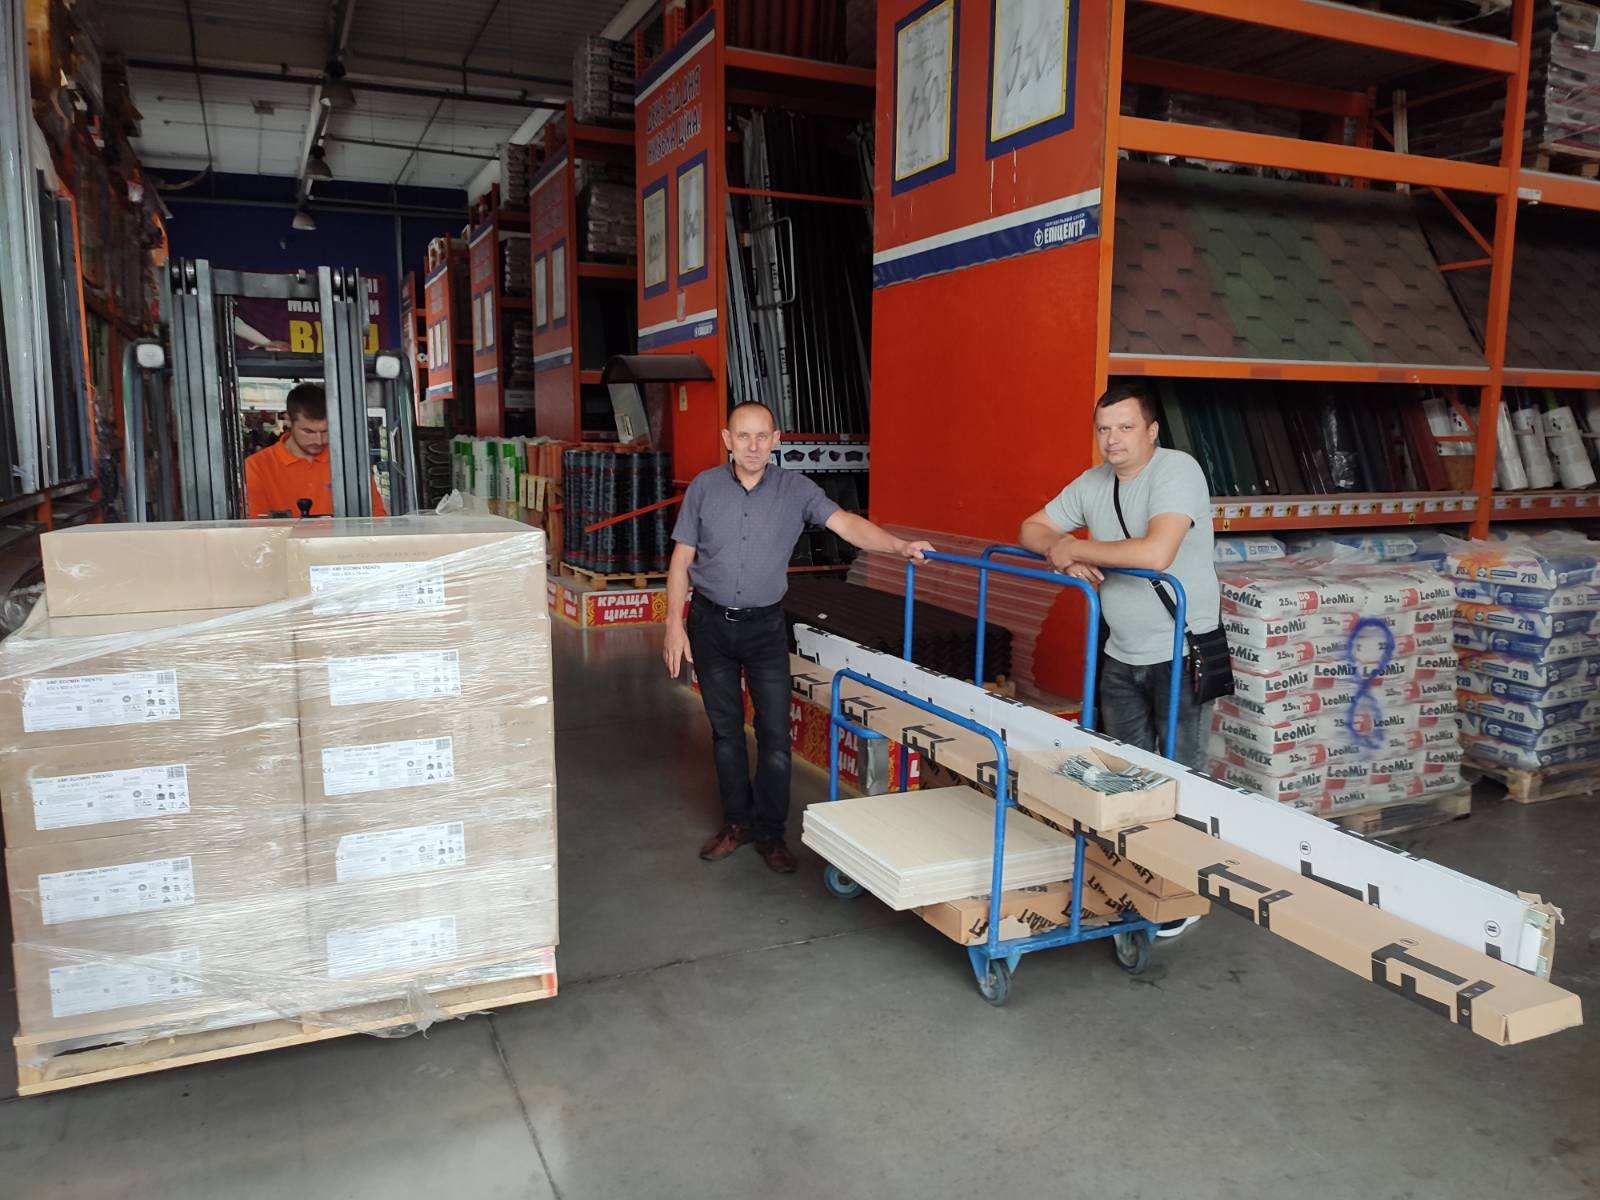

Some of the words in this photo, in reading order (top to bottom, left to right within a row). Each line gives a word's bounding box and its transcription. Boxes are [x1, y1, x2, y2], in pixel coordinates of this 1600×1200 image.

[1044, 219, 1086, 244] ЕПІЦЕНТР
[1521, 573, 1538, 584] 219
[597, 594, 649, 607] КРАЩА
[1221, 584, 1262, 608] LeoMix
[1320, 593, 1354, 605] LeoMix
[1420, 588, 1450, 601] LeoMix
[604, 608, 644, 621] ЦІНА!
[1518, 619, 1535, 631] 219
[1417, 656, 1457, 669] LeoMix
[1315, 663, 1357, 677] LeoMix
[1512, 668, 1529, 681] 219
[1266, 671, 1309, 691] LeoMix
[1420, 703, 1457, 715] LeoMix
[1373, 715, 1405, 728] LeoMix
[1507, 710, 1524, 722] 219
[1222, 721, 1258, 742] LeoMix
[1274, 723, 1316, 742] LeoMix
[1327, 765, 1369, 778] LeoMix
[1372, 759, 1415, 774] LeoMix
[1278, 773, 1321, 792] LeoMix
[1333, 791, 1366, 805] LeoMix
